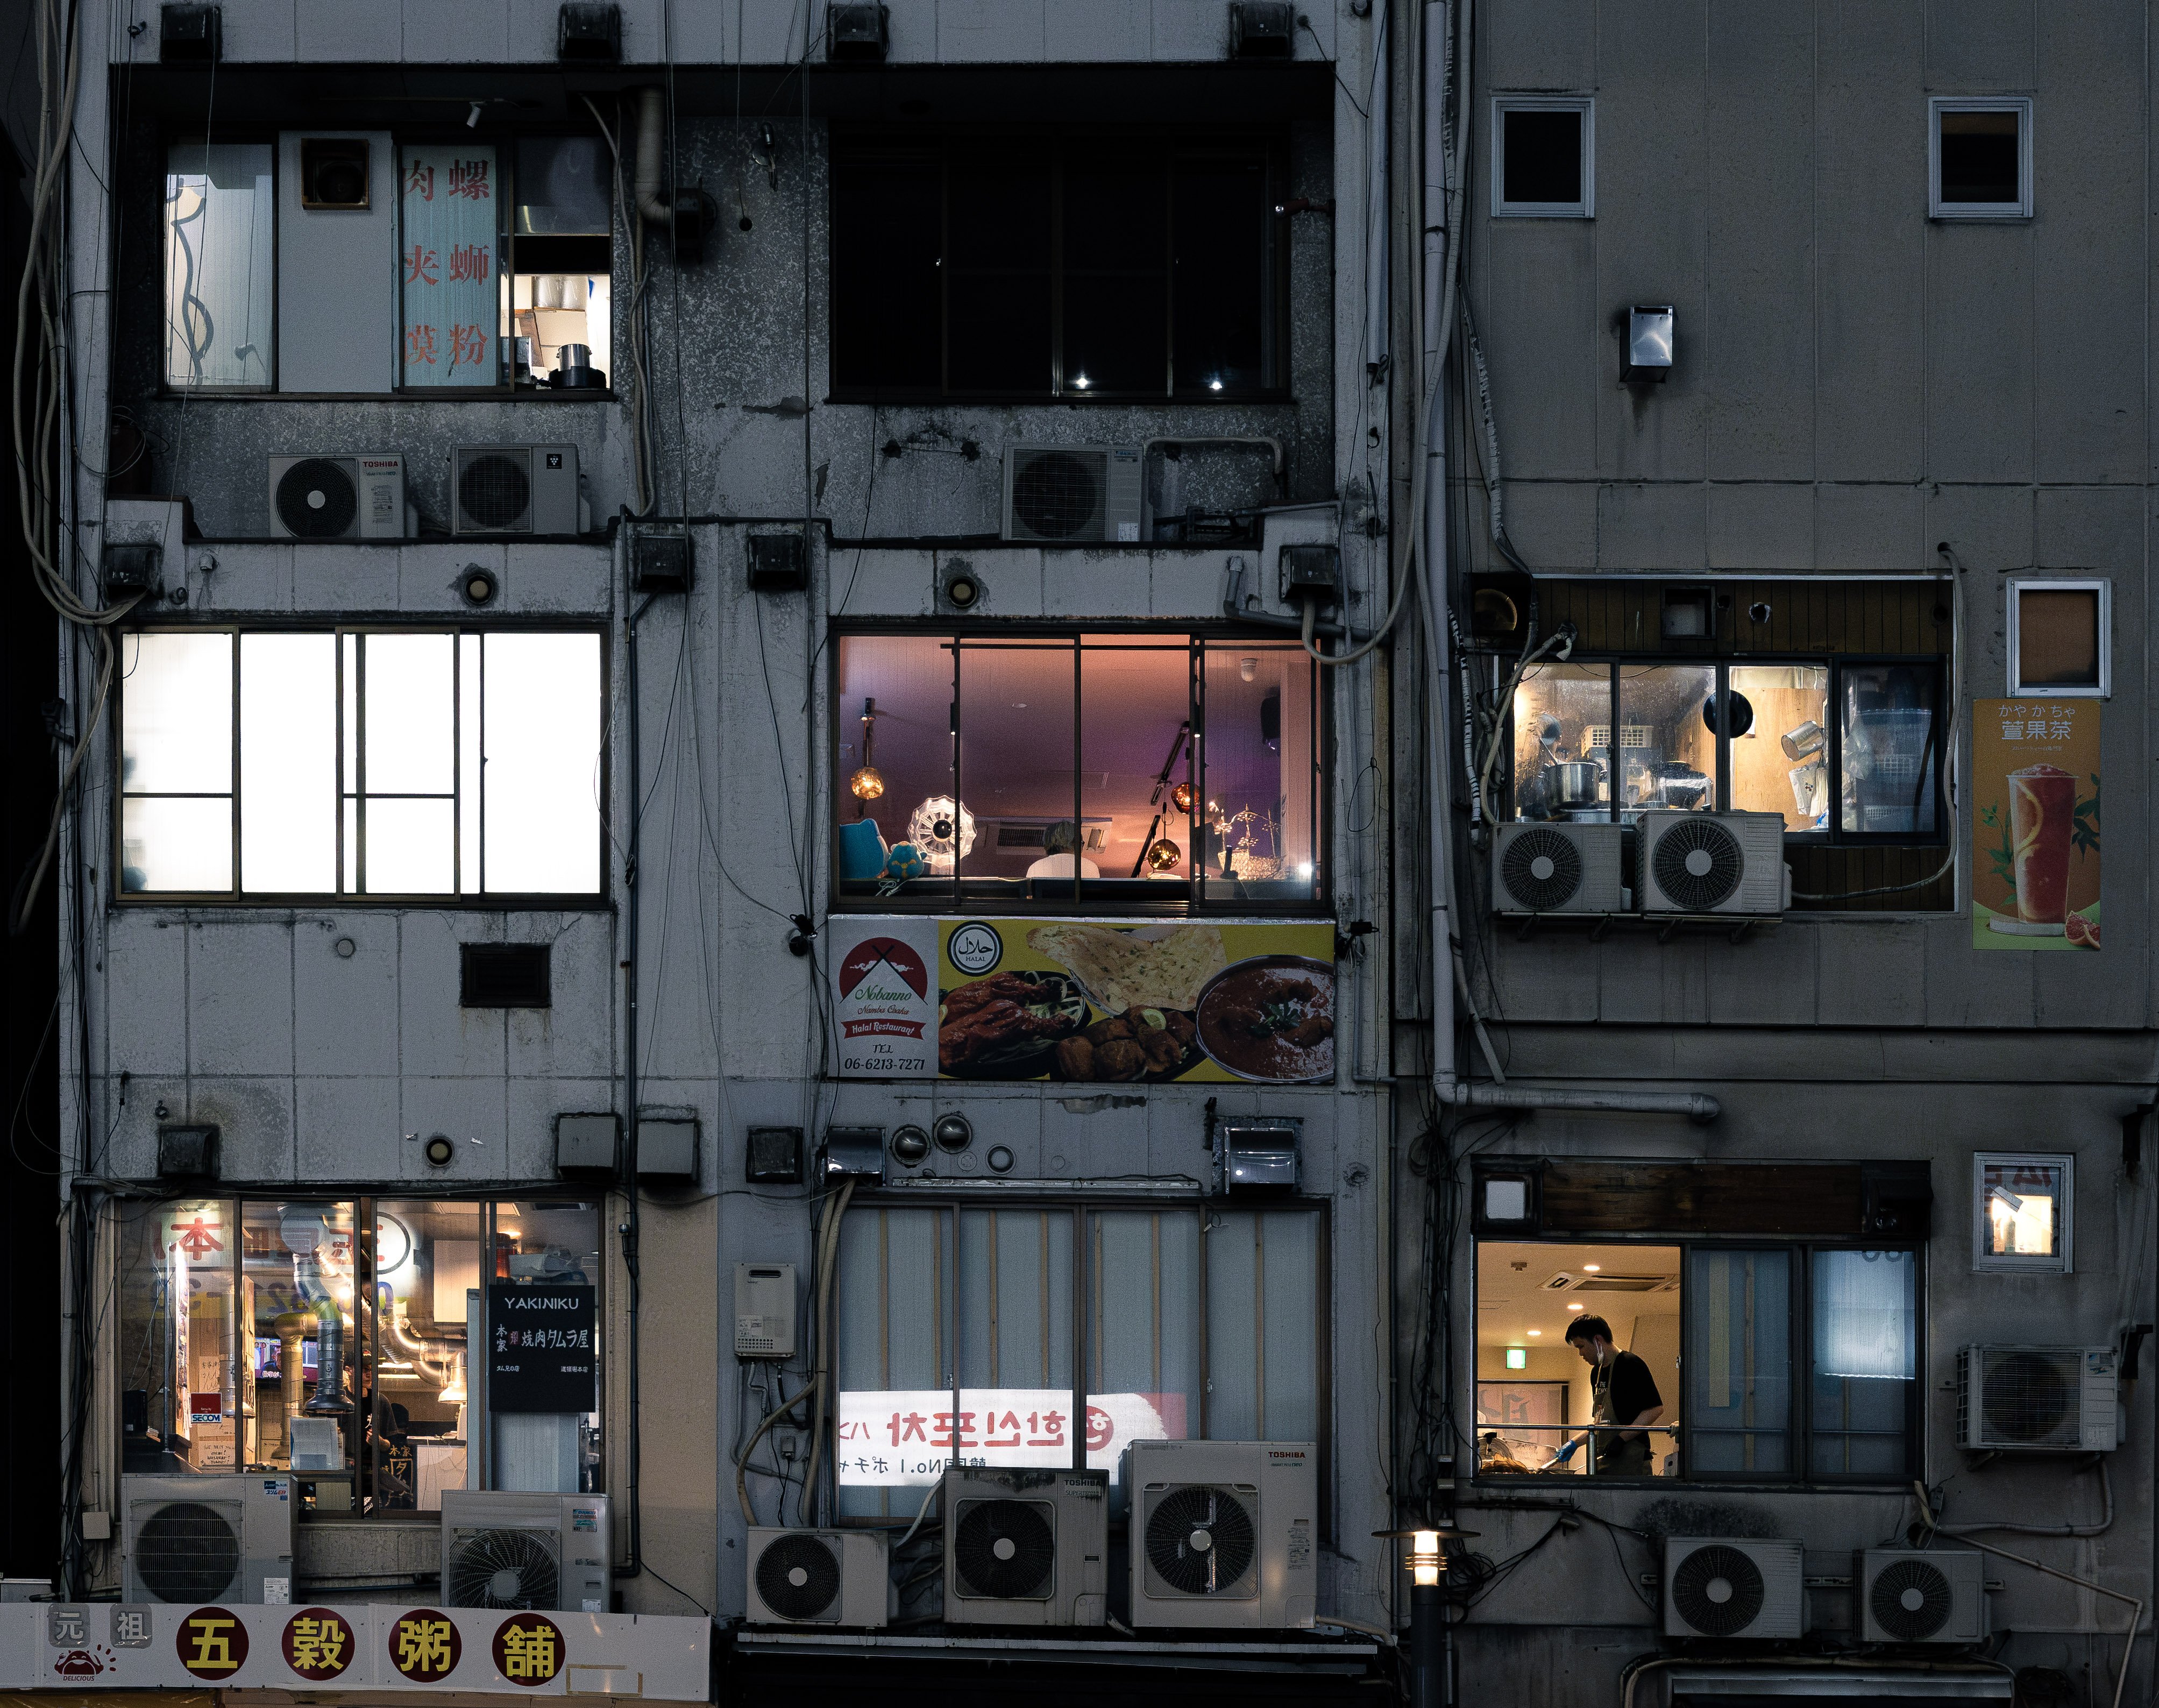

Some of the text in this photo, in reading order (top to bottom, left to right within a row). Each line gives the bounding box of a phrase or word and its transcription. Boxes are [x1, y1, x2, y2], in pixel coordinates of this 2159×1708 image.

[449, 159, 488, 365] 螺蛳粉
[2001, 720, 2072, 740] 萱果茶
[958, 936, 993, 955] حلال
[855, 984, 912, 1001] Nobanno
[857, 1004, 910, 1015] Namba Osaka
[852, 1022, 915, 1035] Halal Restaurant
[872, 1044, 893, 1054] TEL
[844, 1058, 925, 1071] 06-6213-7271
[505, 1298, 579, 1309] YAKINIKU
[496, 1323, 508, 1352] 本家
[521, 1329, 589, 1349] 焼肉タムラ屋
[56, 1612, 150, 1640] 元祖
